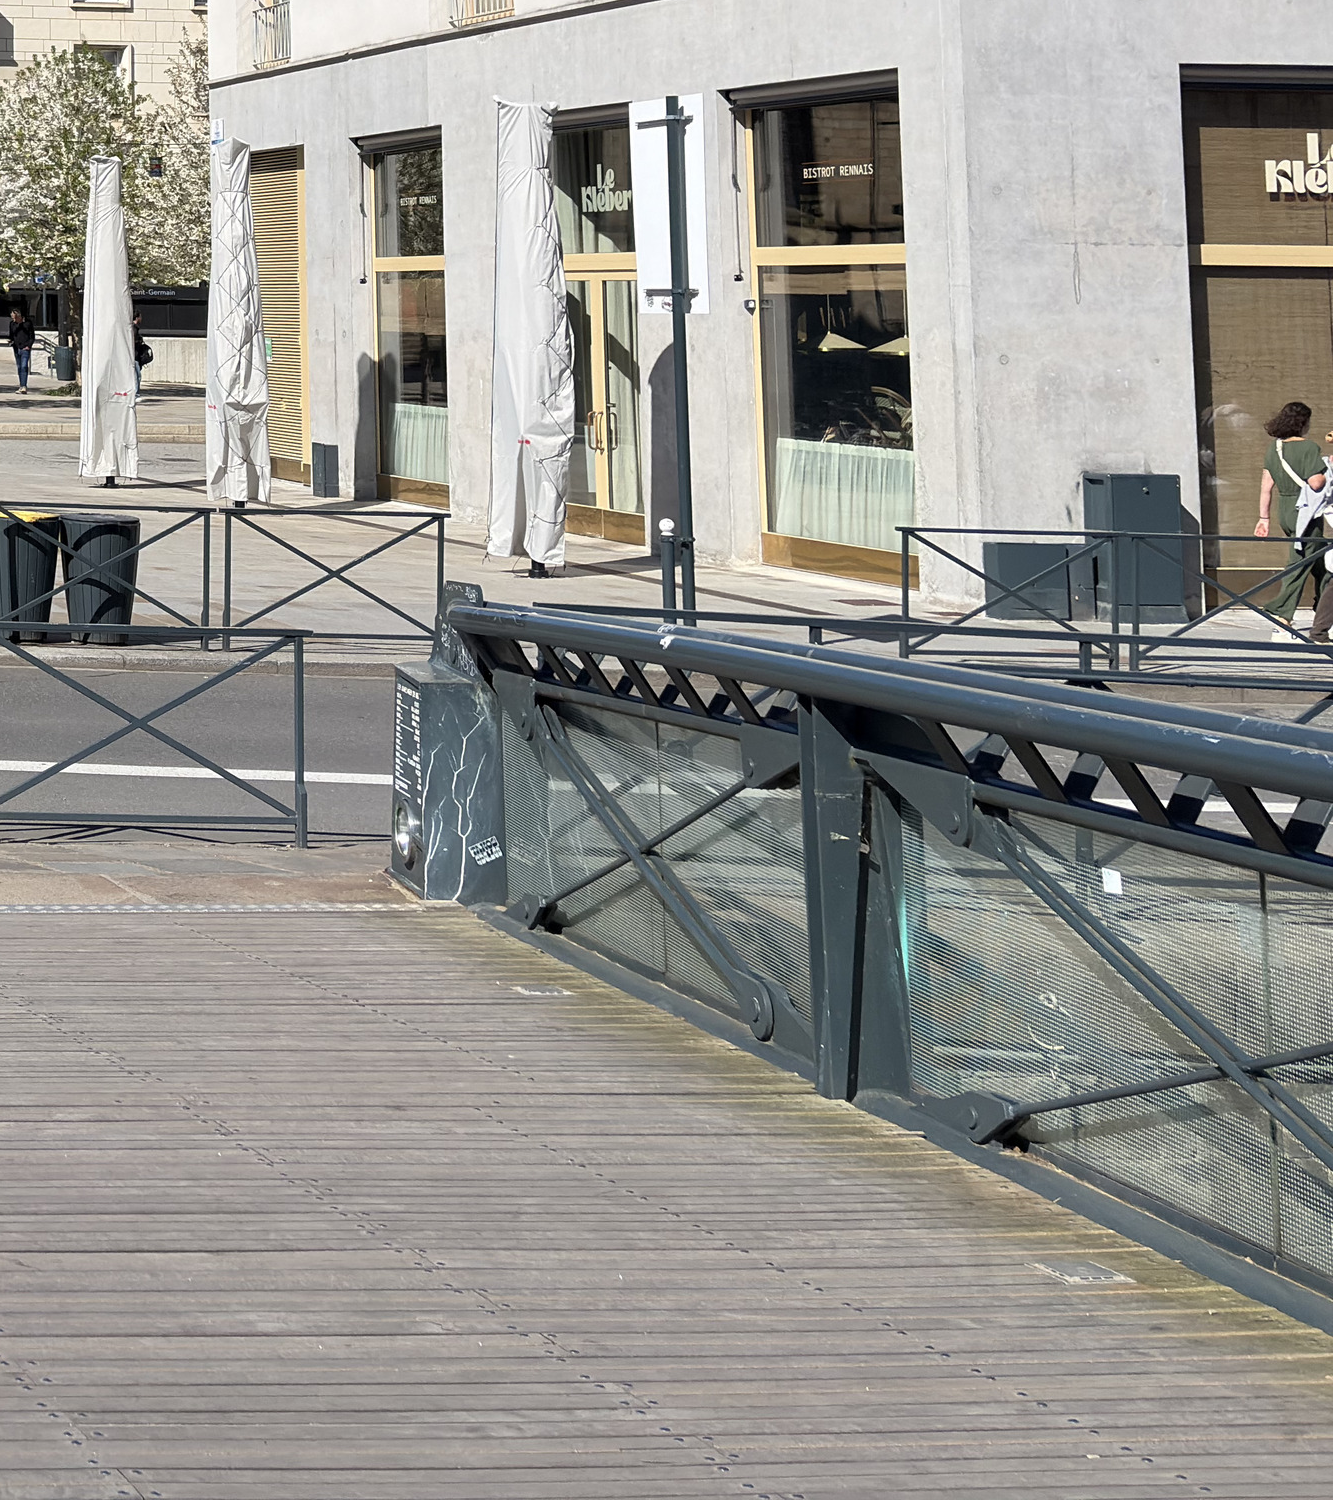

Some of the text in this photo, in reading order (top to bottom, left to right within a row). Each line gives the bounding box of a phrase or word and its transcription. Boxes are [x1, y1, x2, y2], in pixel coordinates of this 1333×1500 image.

[1306, 132, 1333, 165] L
[596, 163, 615, 190] Le
[803, 163, 874, 179] BISTROT RENNAIS
[581, 185, 632, 213] Kléber
